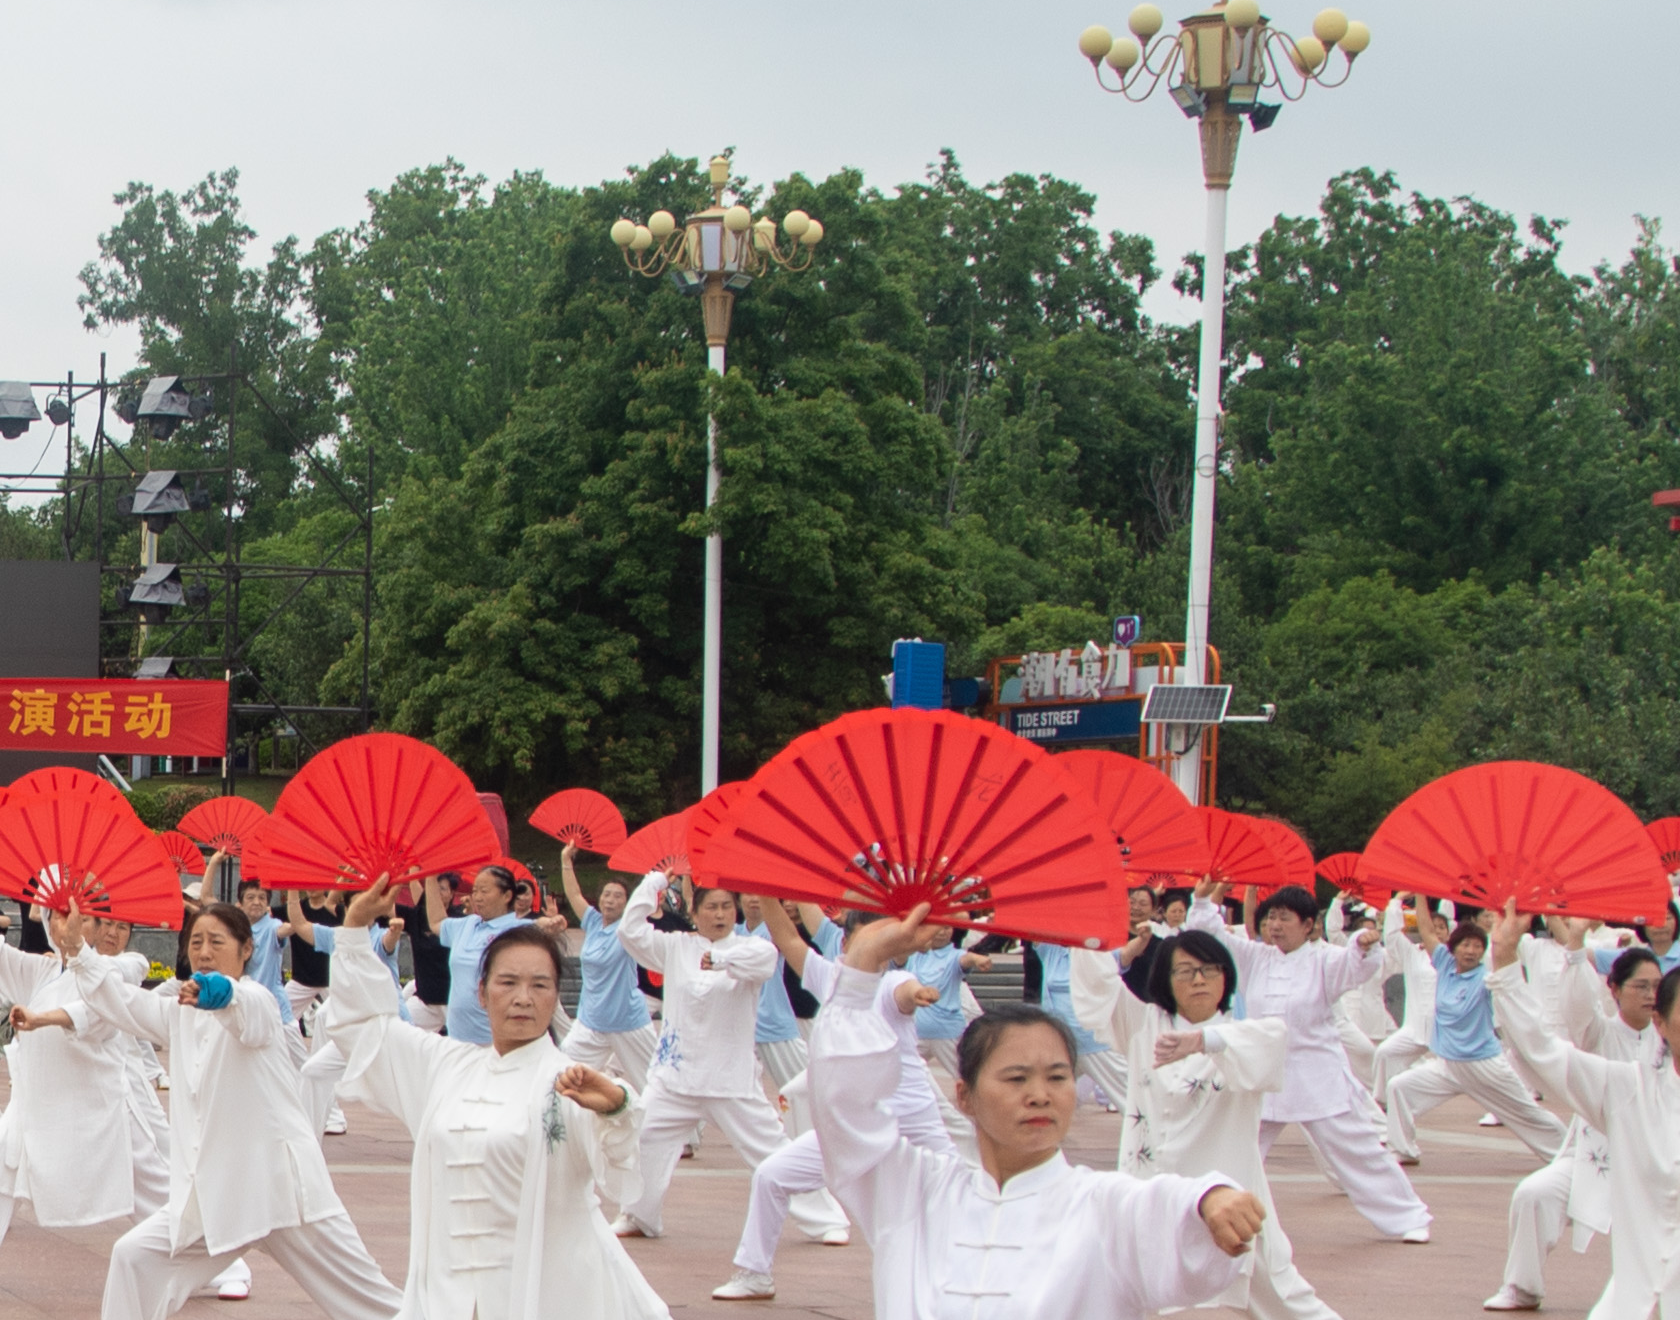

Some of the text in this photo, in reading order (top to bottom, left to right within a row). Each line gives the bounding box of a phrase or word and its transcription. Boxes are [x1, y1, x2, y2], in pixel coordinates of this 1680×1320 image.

[1017, 640, 1130, 700] 潮有食力
[1016, 709, 1080, 728] TIDE STREET
